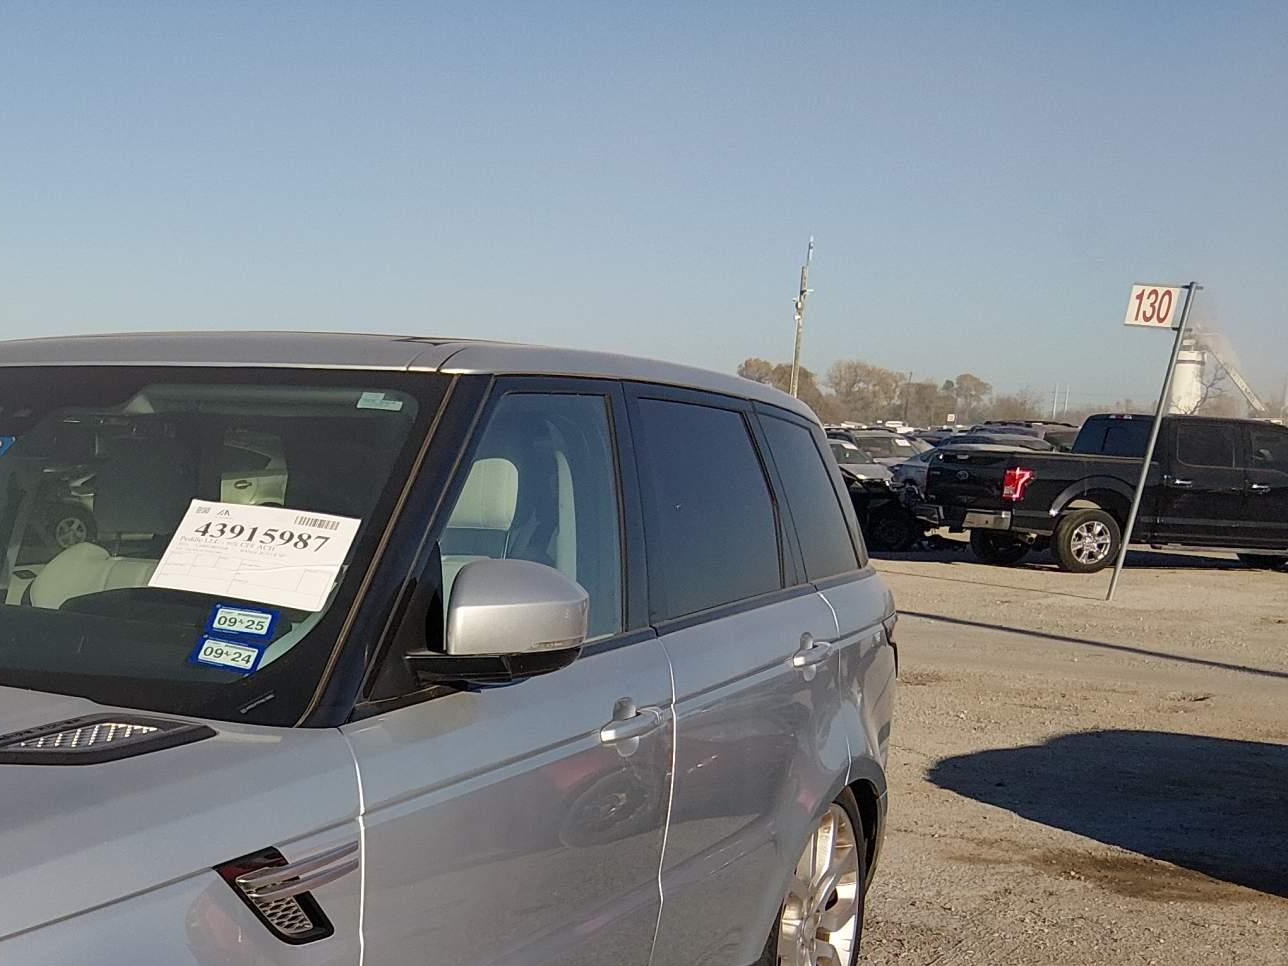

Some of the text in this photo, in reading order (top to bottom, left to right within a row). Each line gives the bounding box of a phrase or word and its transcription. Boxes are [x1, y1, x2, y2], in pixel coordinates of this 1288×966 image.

[1134, 288, 1173, 323] 130
[194, 521, 331, 553] 43915987
[216, 615, 266, 632] 09 25
[203, 646, 224, 659] 09
[230, 651, 252, 665] 24
